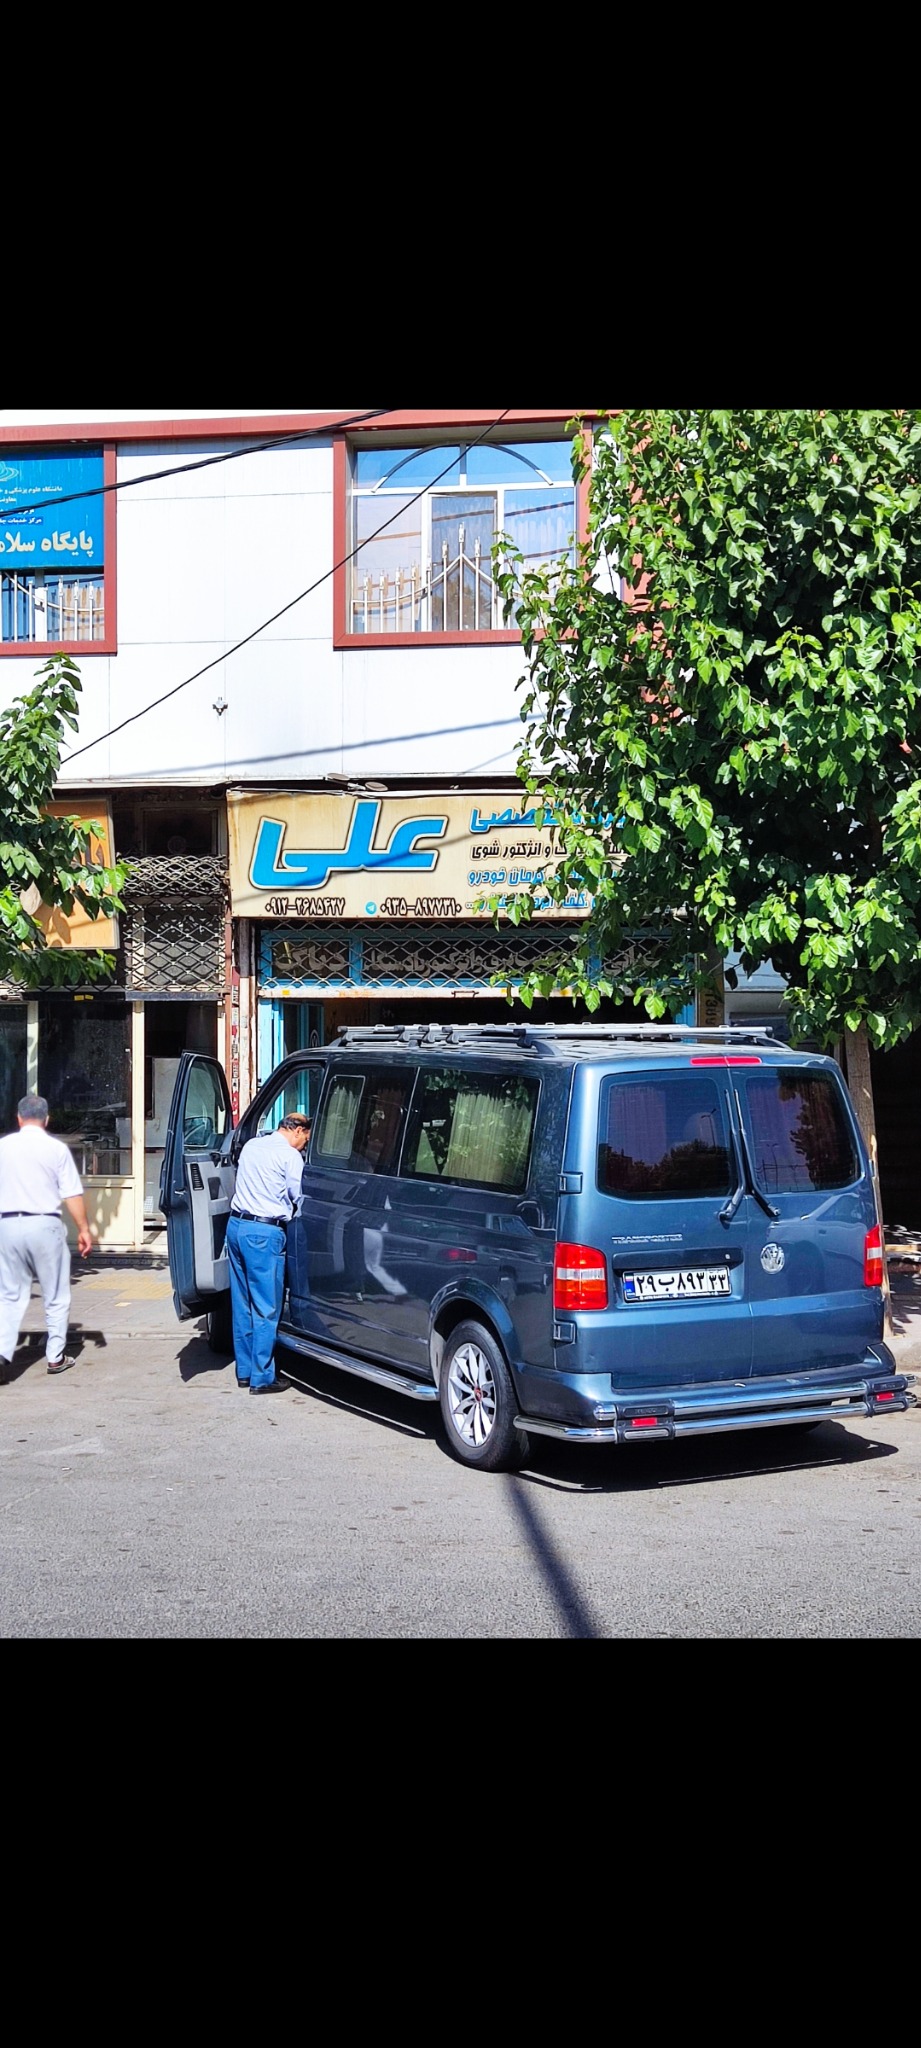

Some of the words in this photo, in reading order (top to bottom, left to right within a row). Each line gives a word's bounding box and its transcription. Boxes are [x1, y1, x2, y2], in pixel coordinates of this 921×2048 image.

[0, 531, 36, 553] سلام
[41, 529, 94, 558] پایگاه
[249, 799, 448, 890] علی
[471, 840, 501, 860] شوی
[503, 840, 543, 859] انژکتور
[468, 870, 507, 886] خودرو
[708, 1274, 727, 1291] ۳۳
